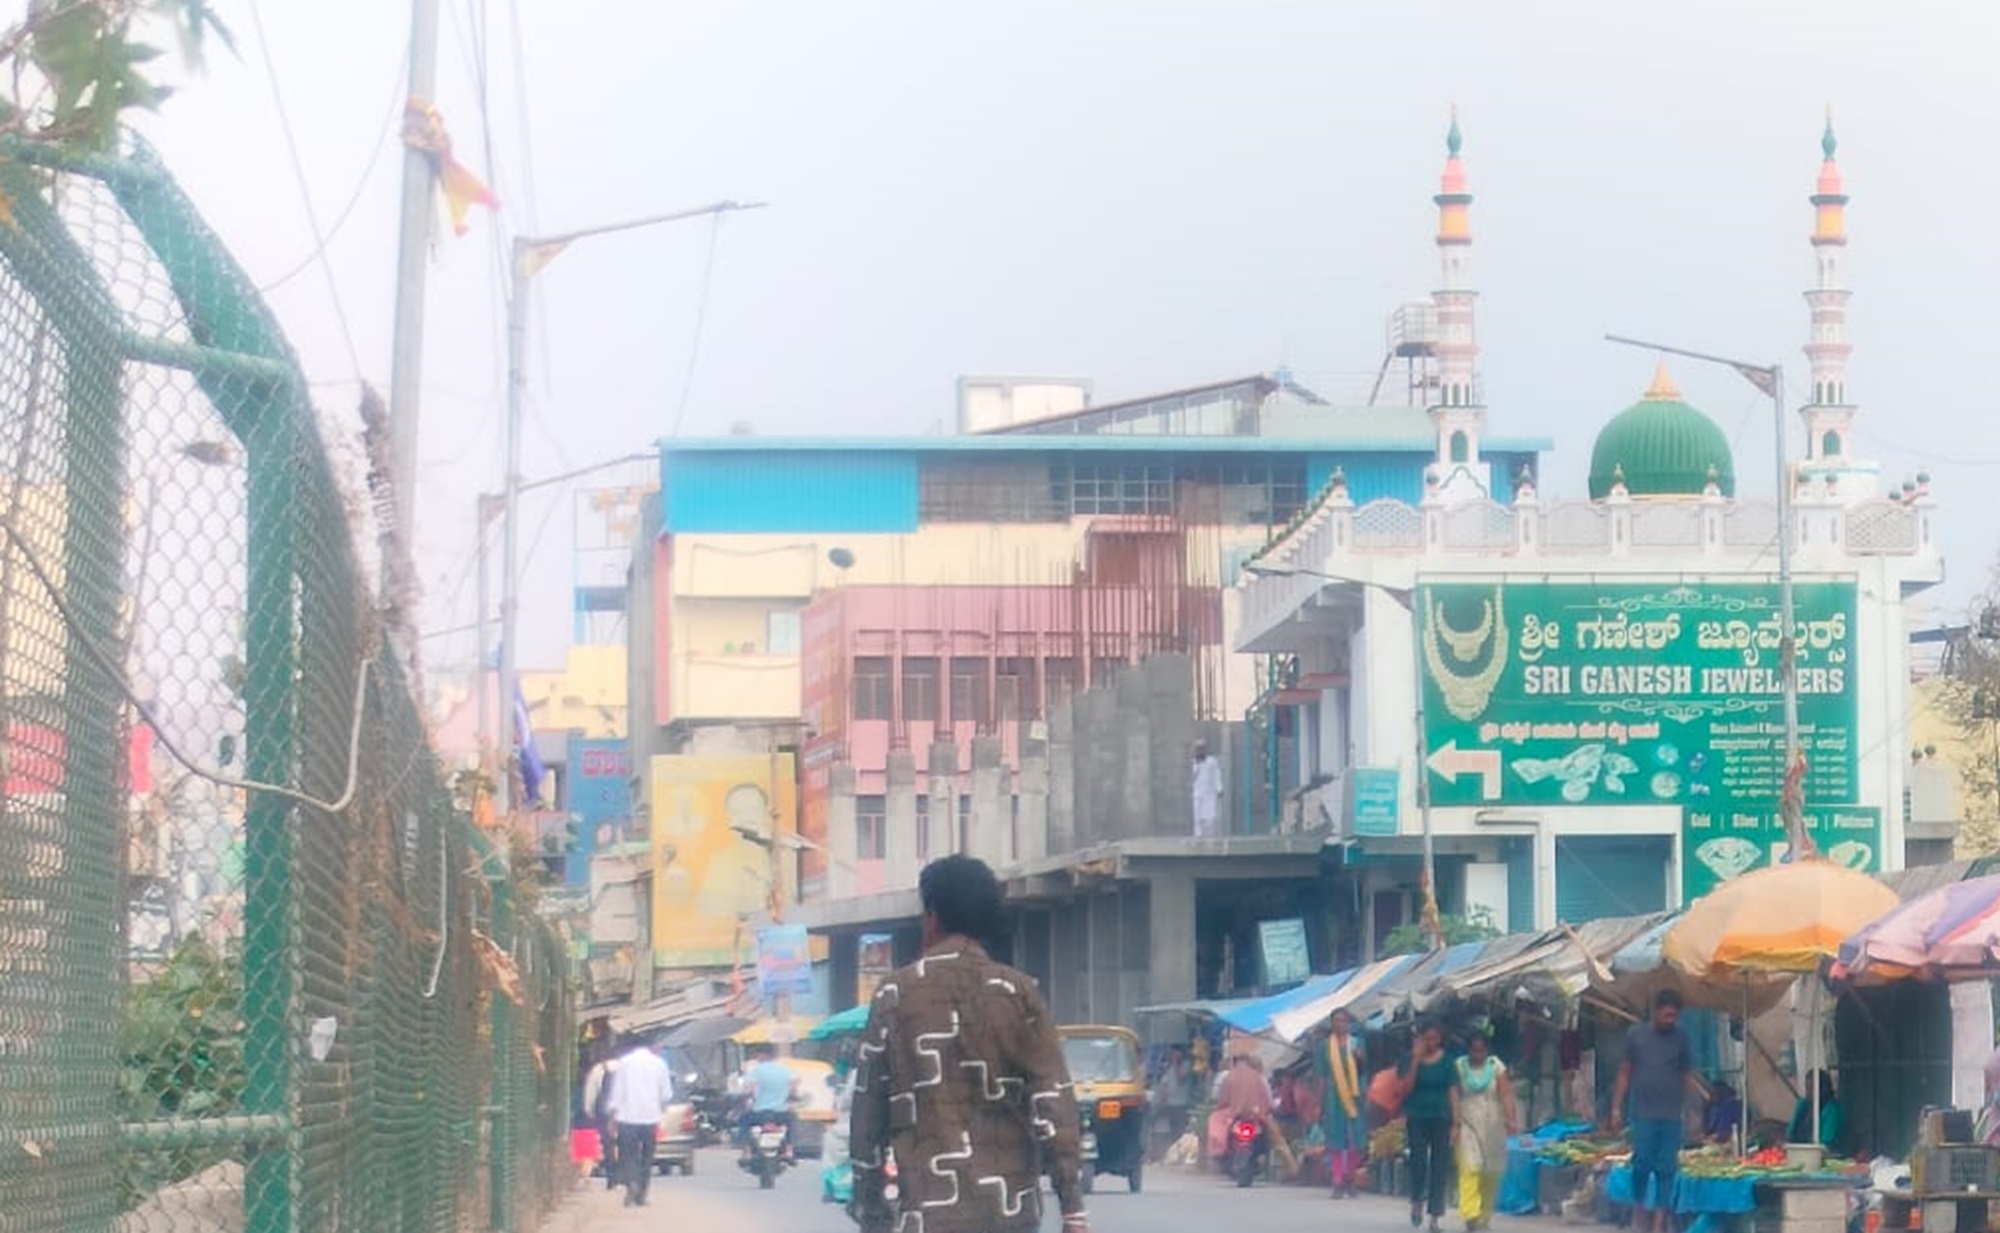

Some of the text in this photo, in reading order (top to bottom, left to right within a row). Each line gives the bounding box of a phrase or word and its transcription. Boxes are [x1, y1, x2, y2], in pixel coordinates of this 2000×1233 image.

[1577, 611, 1681, 649] ಗಣೇಶ್
[1524, 665, 1844, 694] SRI GANESH JEWELERS
